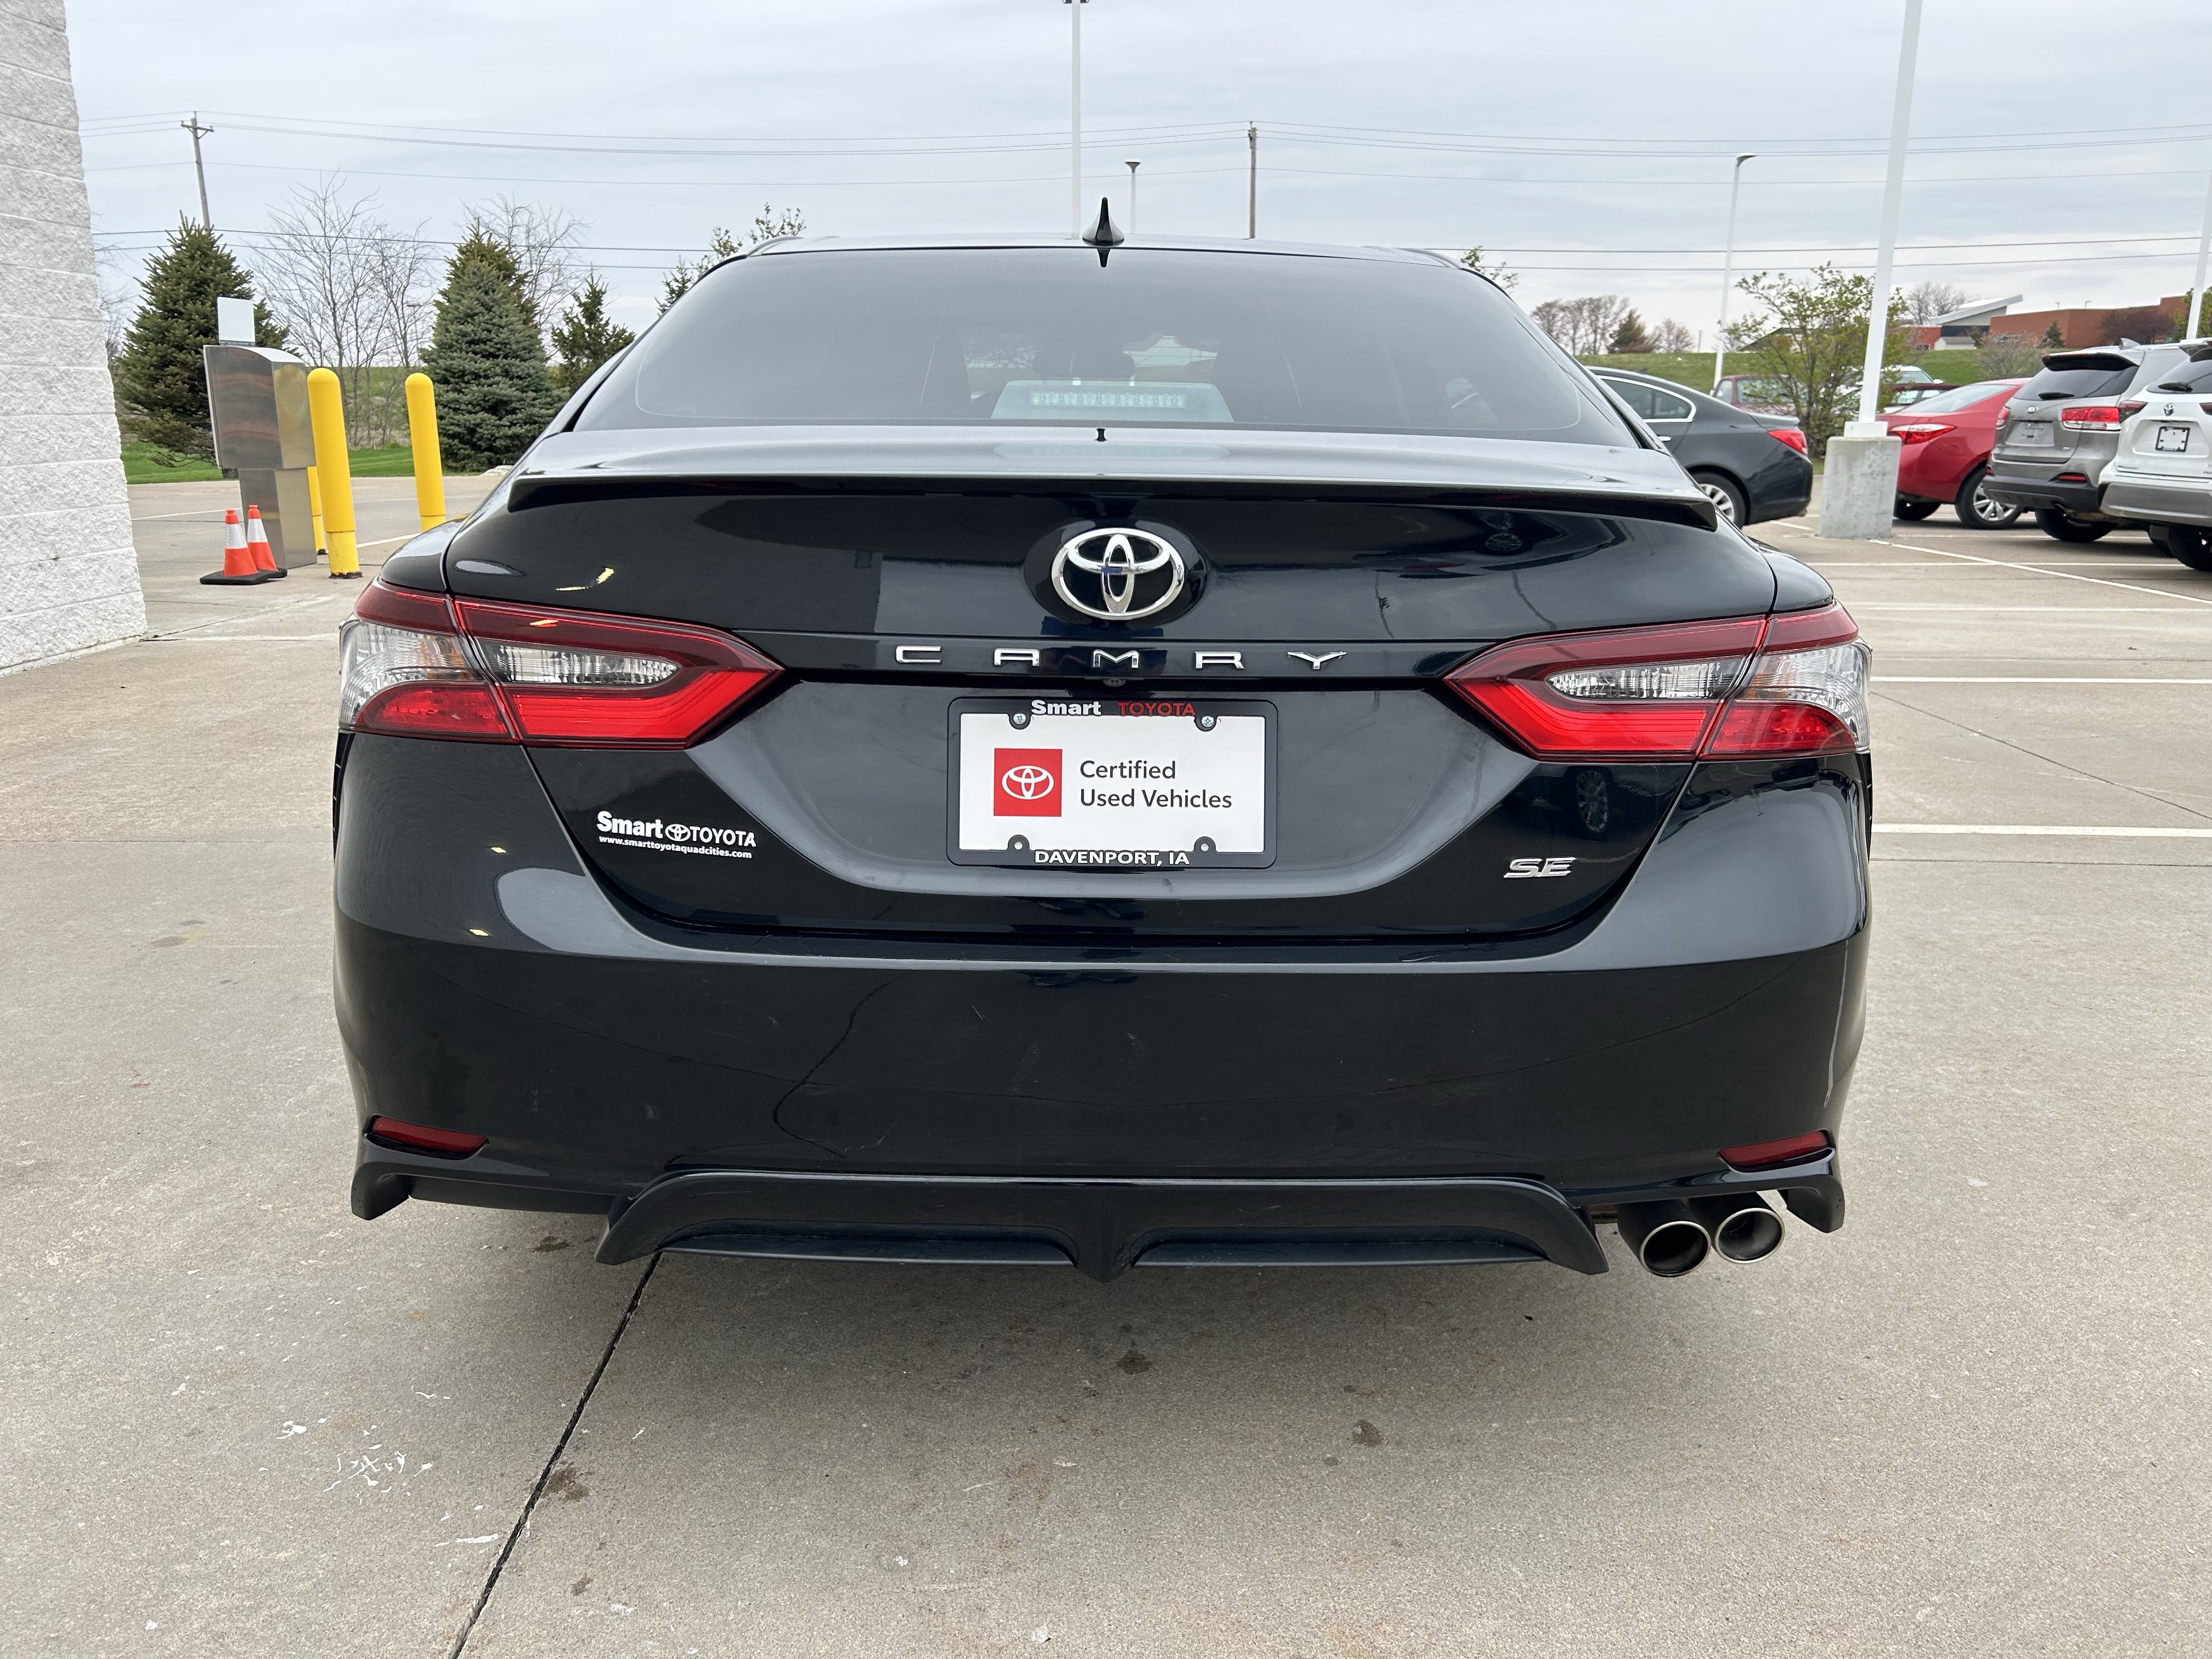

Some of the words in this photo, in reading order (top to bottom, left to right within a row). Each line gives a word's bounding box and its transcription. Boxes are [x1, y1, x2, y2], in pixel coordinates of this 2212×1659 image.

[895, 644, 1347, 670] CAMRY
[1031, 699, 1102, 716] Smart
[1117, 702, 1197, 717] TOYOTA
[1080, 760, 1176, 780] Certified
[1081, 789, 1135, 808] Used
[1142, 789, 1232, 809] Vehicles
[596, 811, 663, 838] Smart
[690, 826, 757, 847] TOYOTA
[599, 836, 752, 859] www.smarttoyotaquadcities.com
[1035, 851, 1163, 867] DAVENPORT,
[1169, 852, 1190, 865] IA
[1503, 857, 1577, 878] SE
